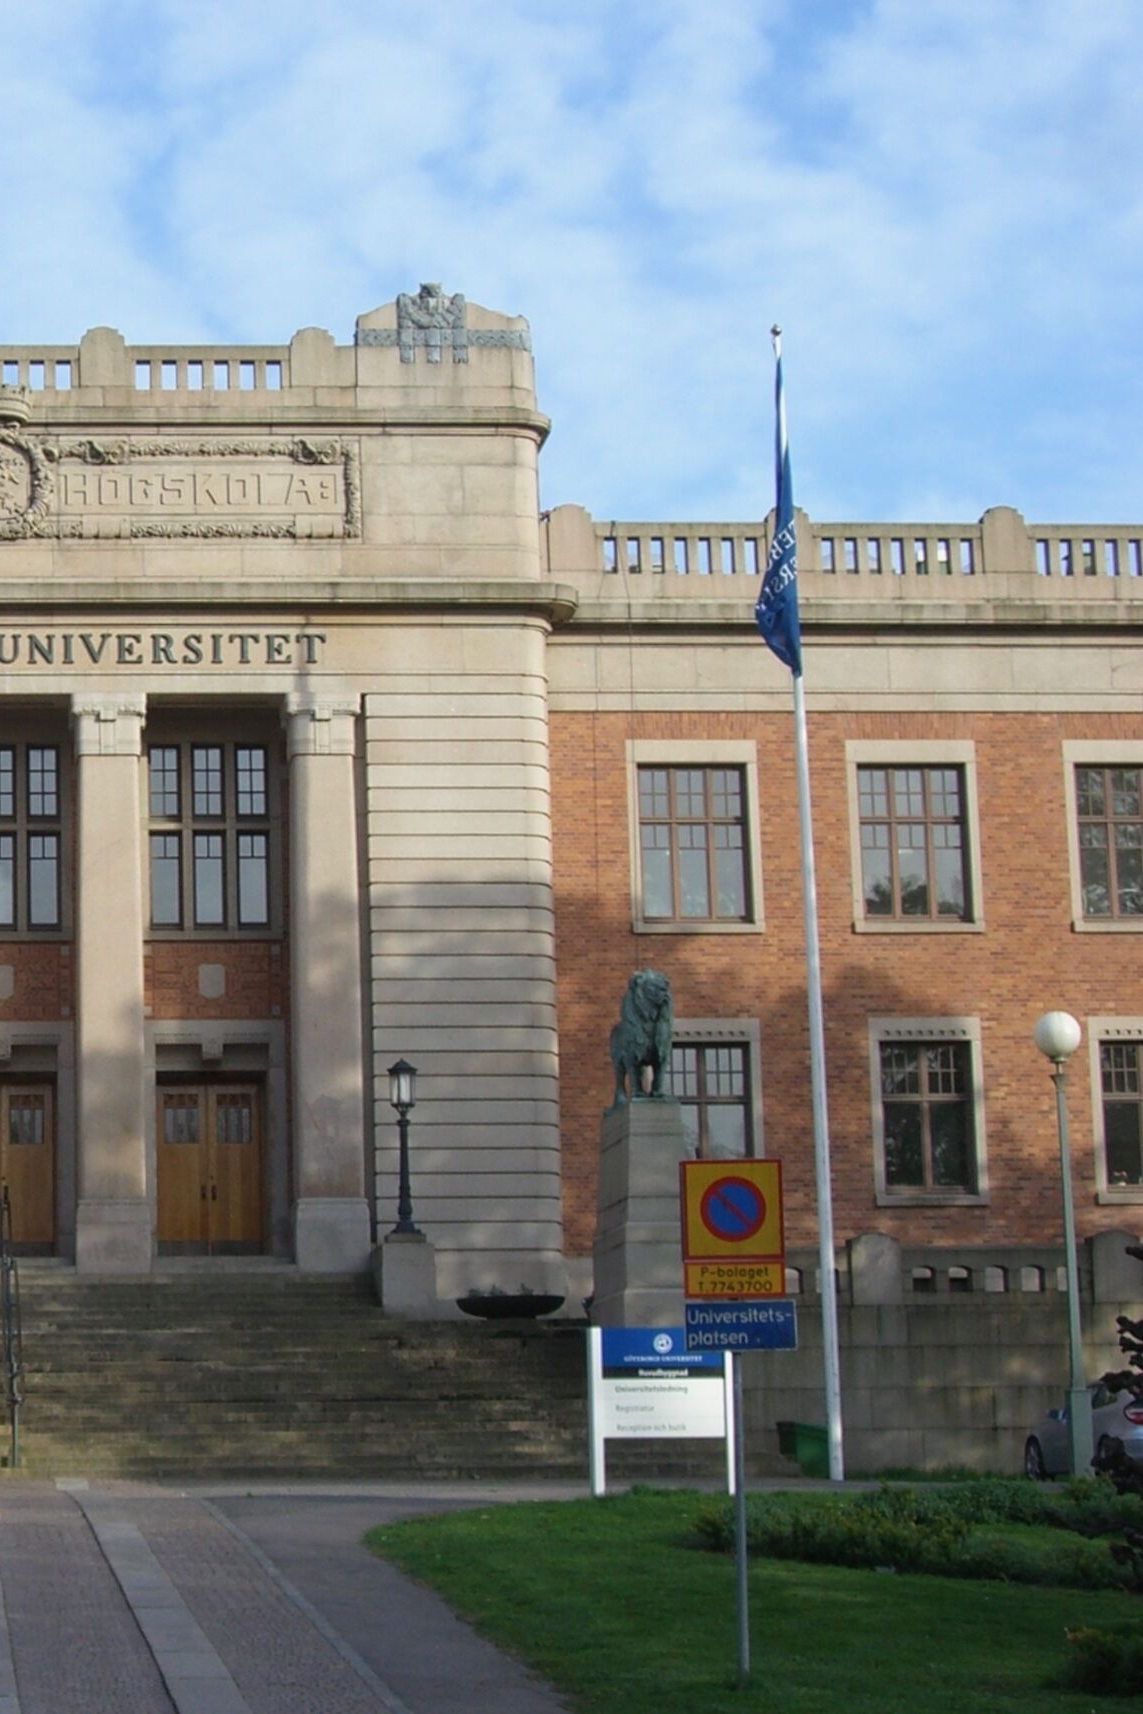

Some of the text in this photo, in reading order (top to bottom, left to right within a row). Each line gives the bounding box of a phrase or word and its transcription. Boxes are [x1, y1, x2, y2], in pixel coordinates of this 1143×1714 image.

[700, 1266, 769, 1280] P-bolaget
[687, 1308, 791, 1325] Universitets-
[688, 1330, 748, 1349] platsen
[615, 1386, 688, 1394] Universitetsledning
